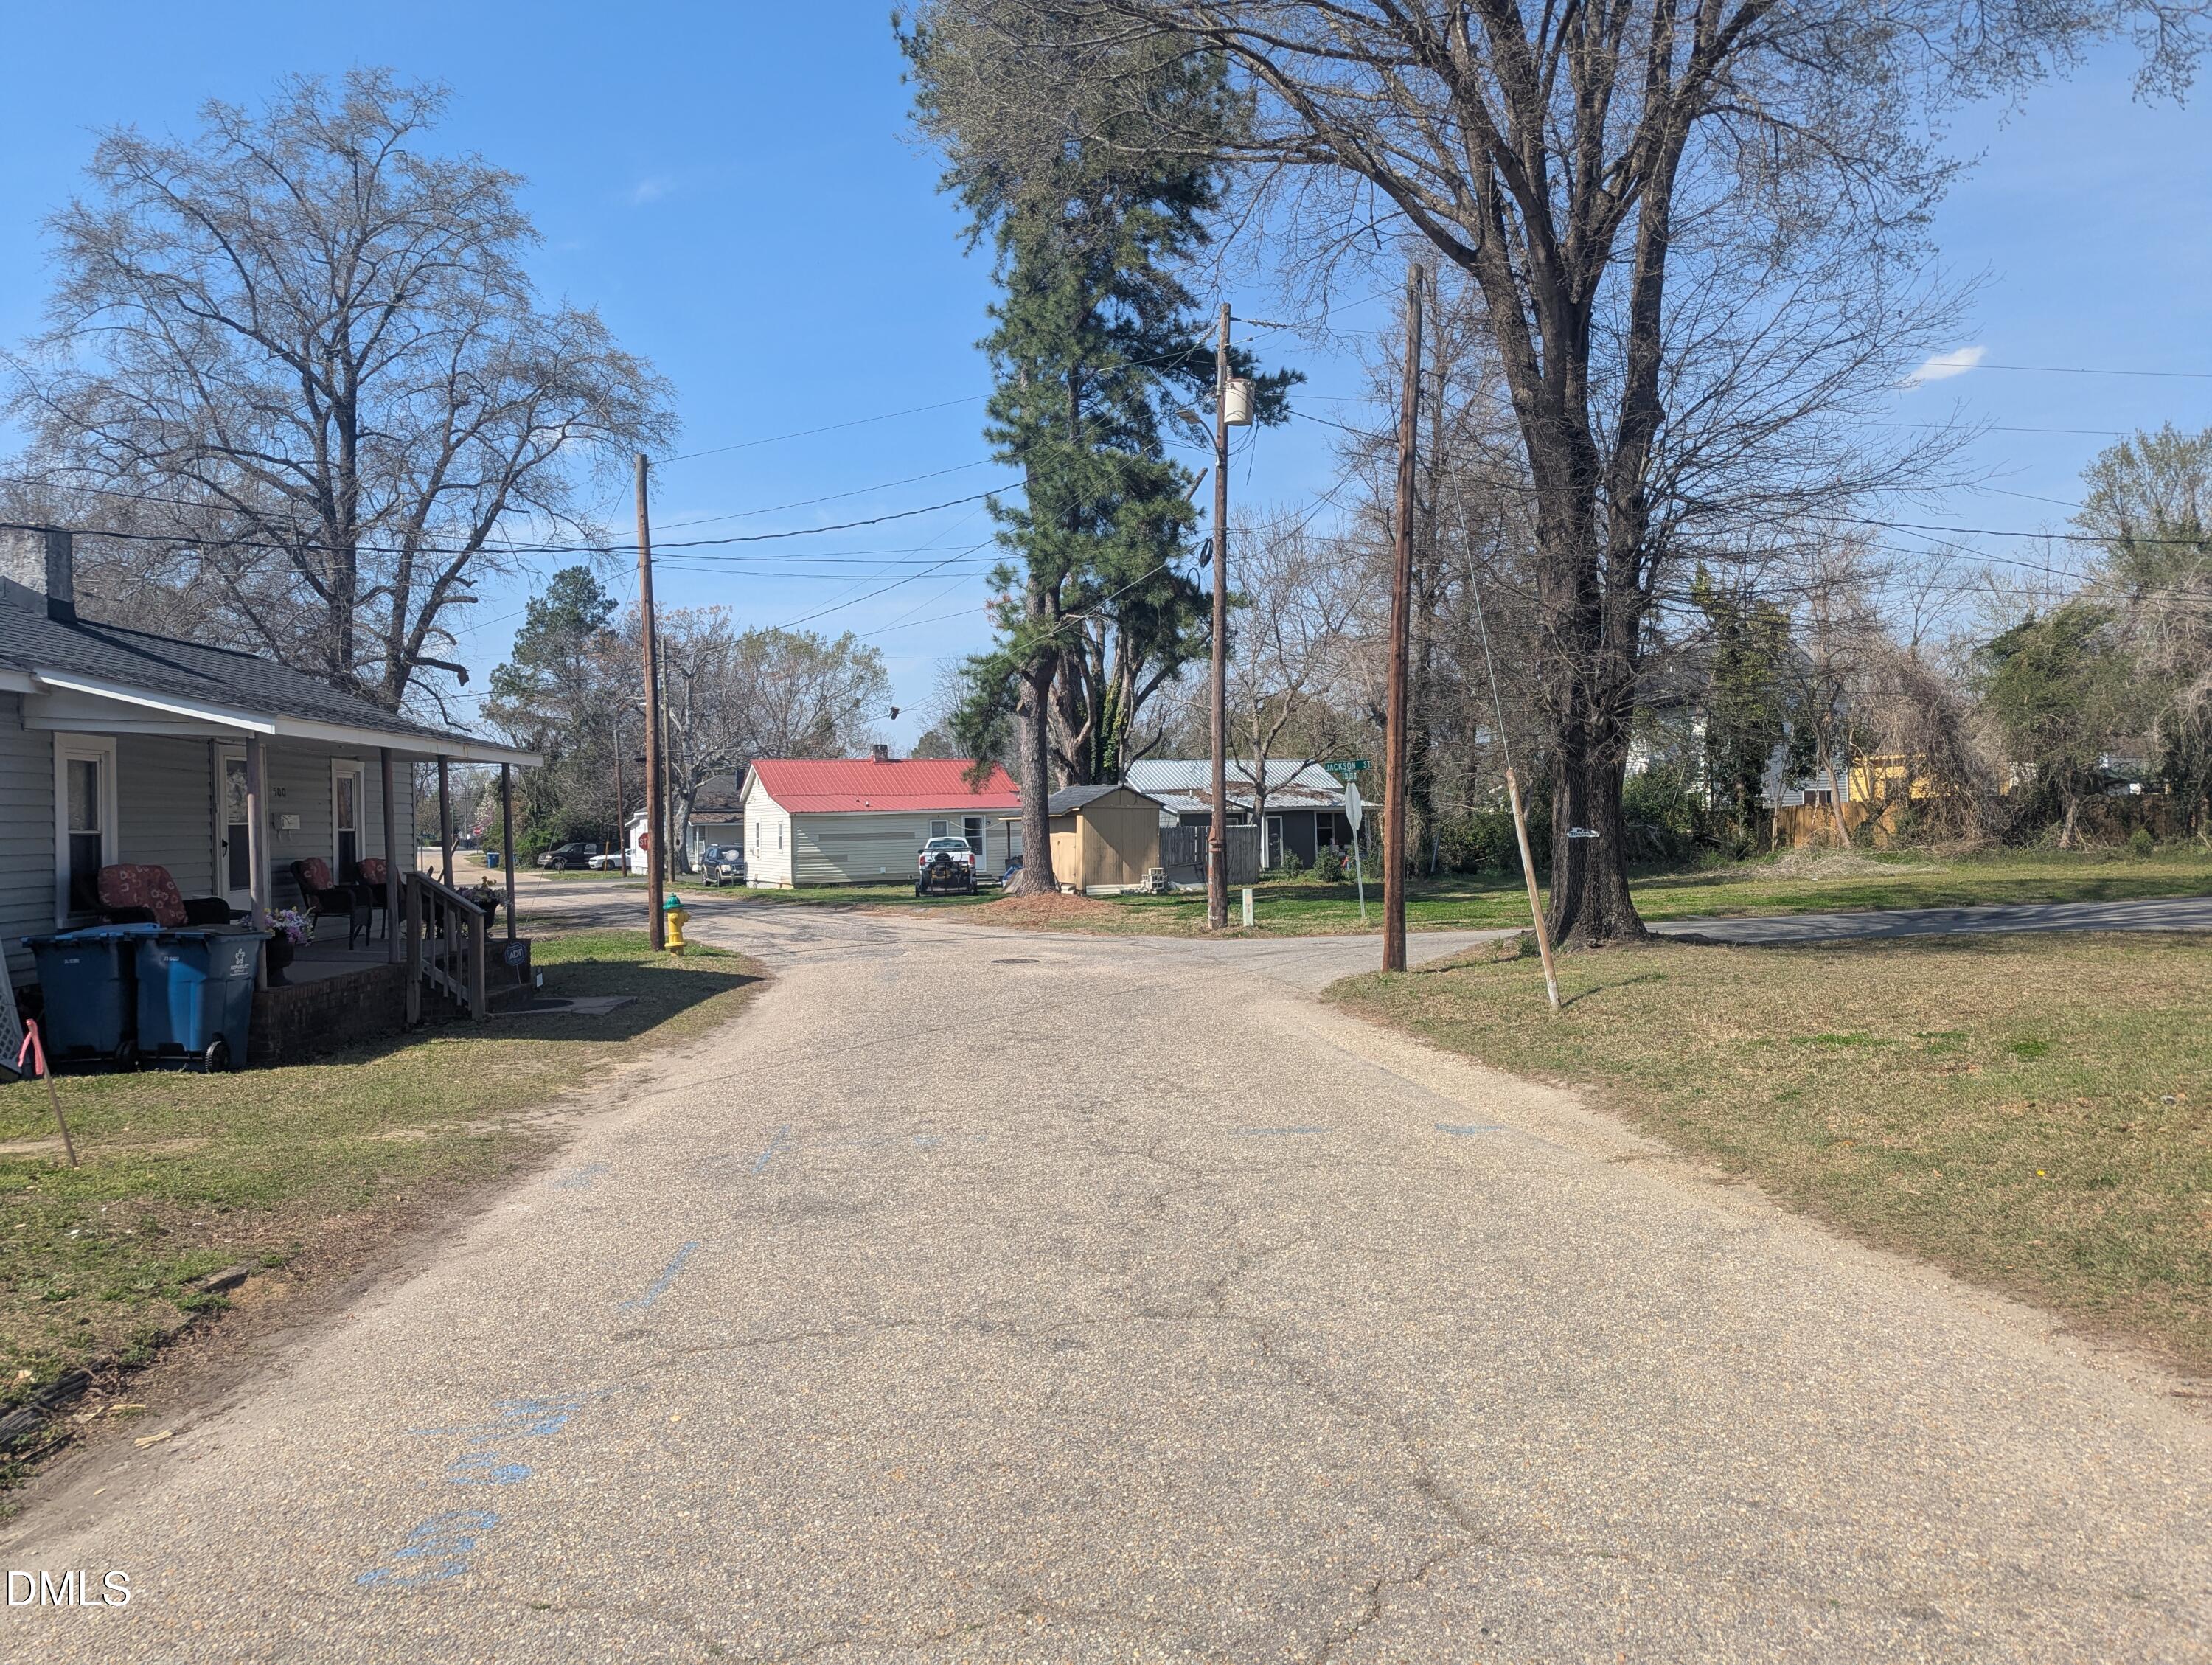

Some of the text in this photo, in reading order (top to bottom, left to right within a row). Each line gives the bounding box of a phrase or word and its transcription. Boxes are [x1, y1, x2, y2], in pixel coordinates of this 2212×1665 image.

[1326, 760, 1371, 771] JACKSON ST
[273, 787, 286, 797] 500
[508, 948, 523, 960] ADT
